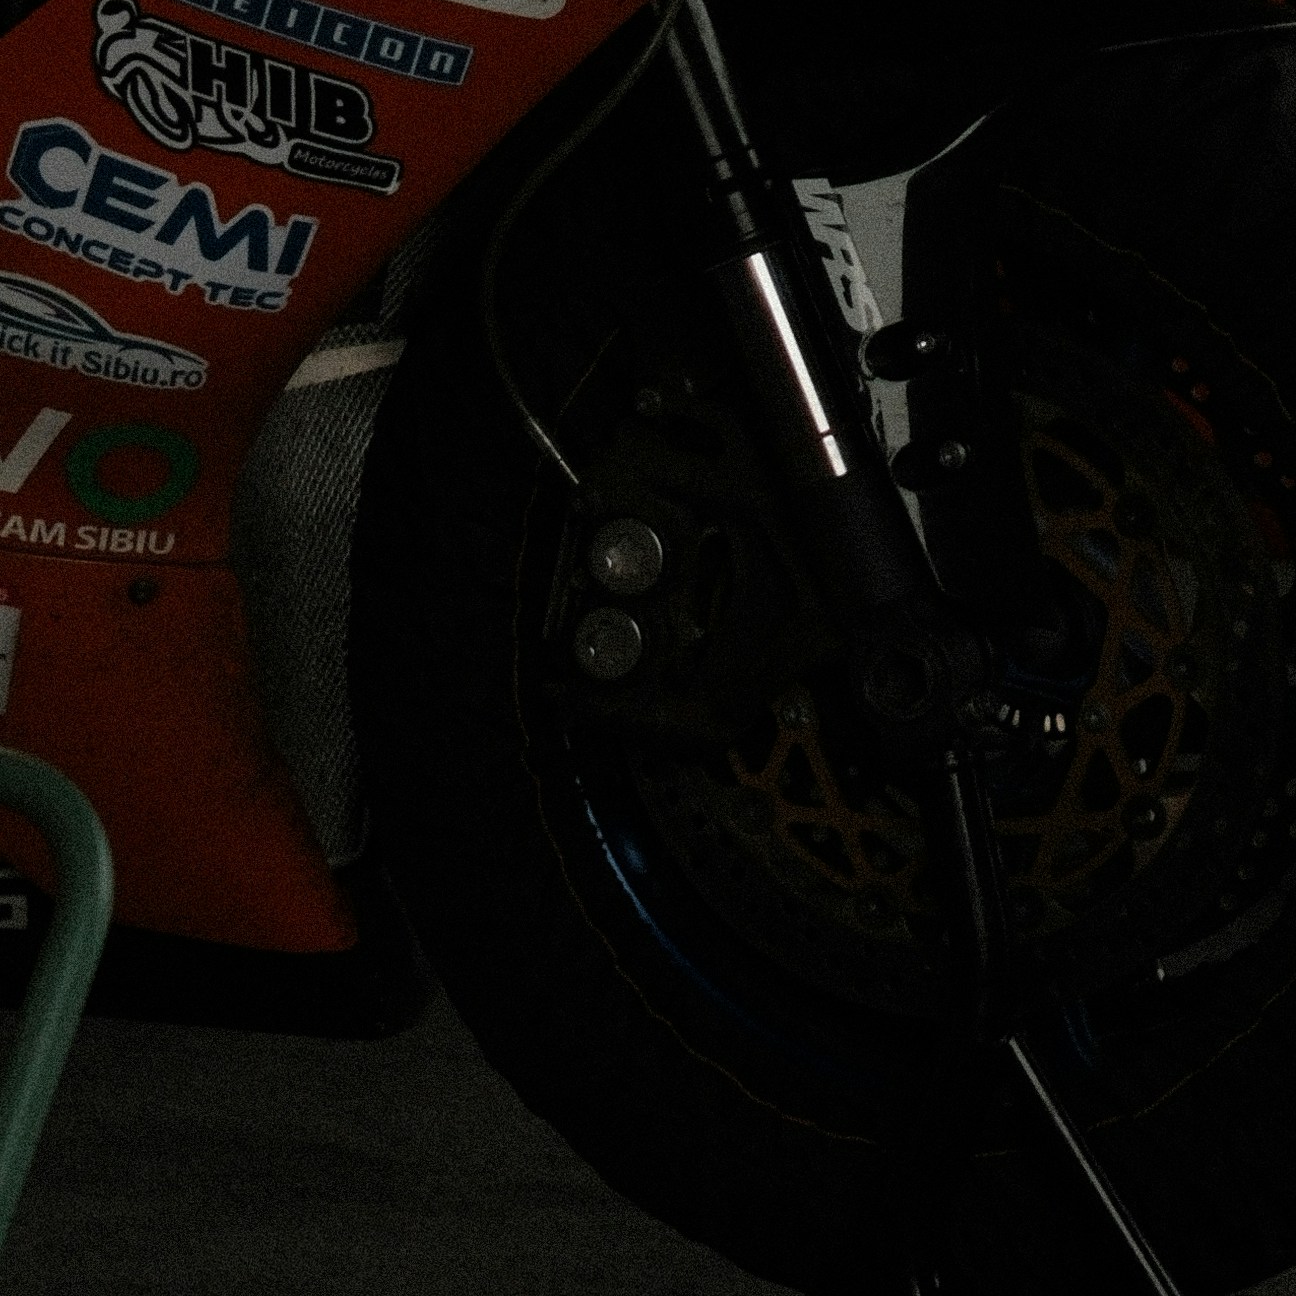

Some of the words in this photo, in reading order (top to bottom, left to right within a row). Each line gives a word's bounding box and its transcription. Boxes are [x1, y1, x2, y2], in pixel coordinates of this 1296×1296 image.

[186, 33, 376, 146] HIB
[10, 123, 314, 277] CEMI
[291, 147, 390, 182] Motorcycles
[0, 206, 194, 293] CONCEPT
[203, 280, 287, 310] TEC
[49, 340, 73, 367] it
[80, 350, 204, 388] Sibiu.ro
[73, 523, 177, 556] SIBIU
